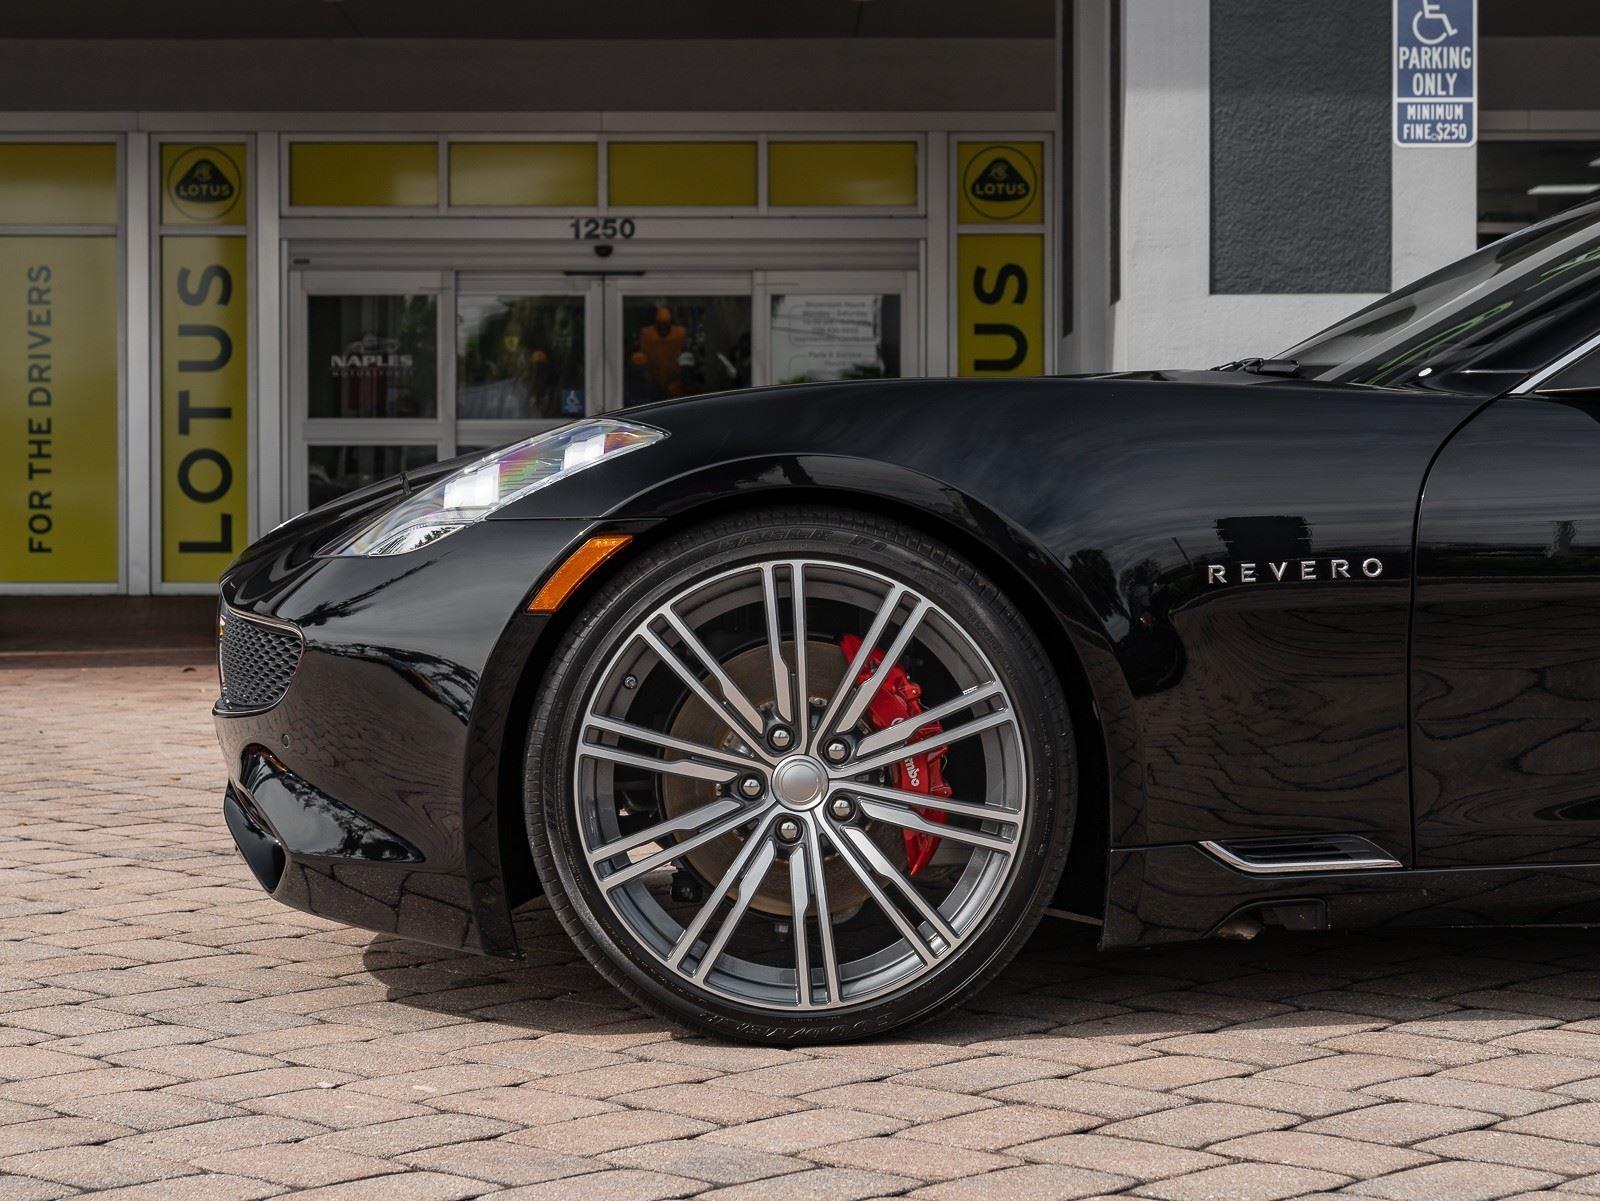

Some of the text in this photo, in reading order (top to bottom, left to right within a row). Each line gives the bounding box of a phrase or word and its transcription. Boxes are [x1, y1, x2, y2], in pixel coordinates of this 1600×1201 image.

[1399, 46, 1472, 70] PARKING
[1412, 73, 1458, 96] ONLY
[1406, 104, 1464, 121] MINIMUM
[1403, 122, 1467, 141] FINE $250
[178, 182, 231, 198] LOTUS
[974, 183, 1028, 196] LOTUS
[570, 218, 636, 240] 1250
[330, 354, 413, 367] NAPLES
[28, 264, 52, 554] FOR THE DRIVERS
[178, 264, 233, 553] LOTUS
[1207, 557, 1384, 585] REVERO
